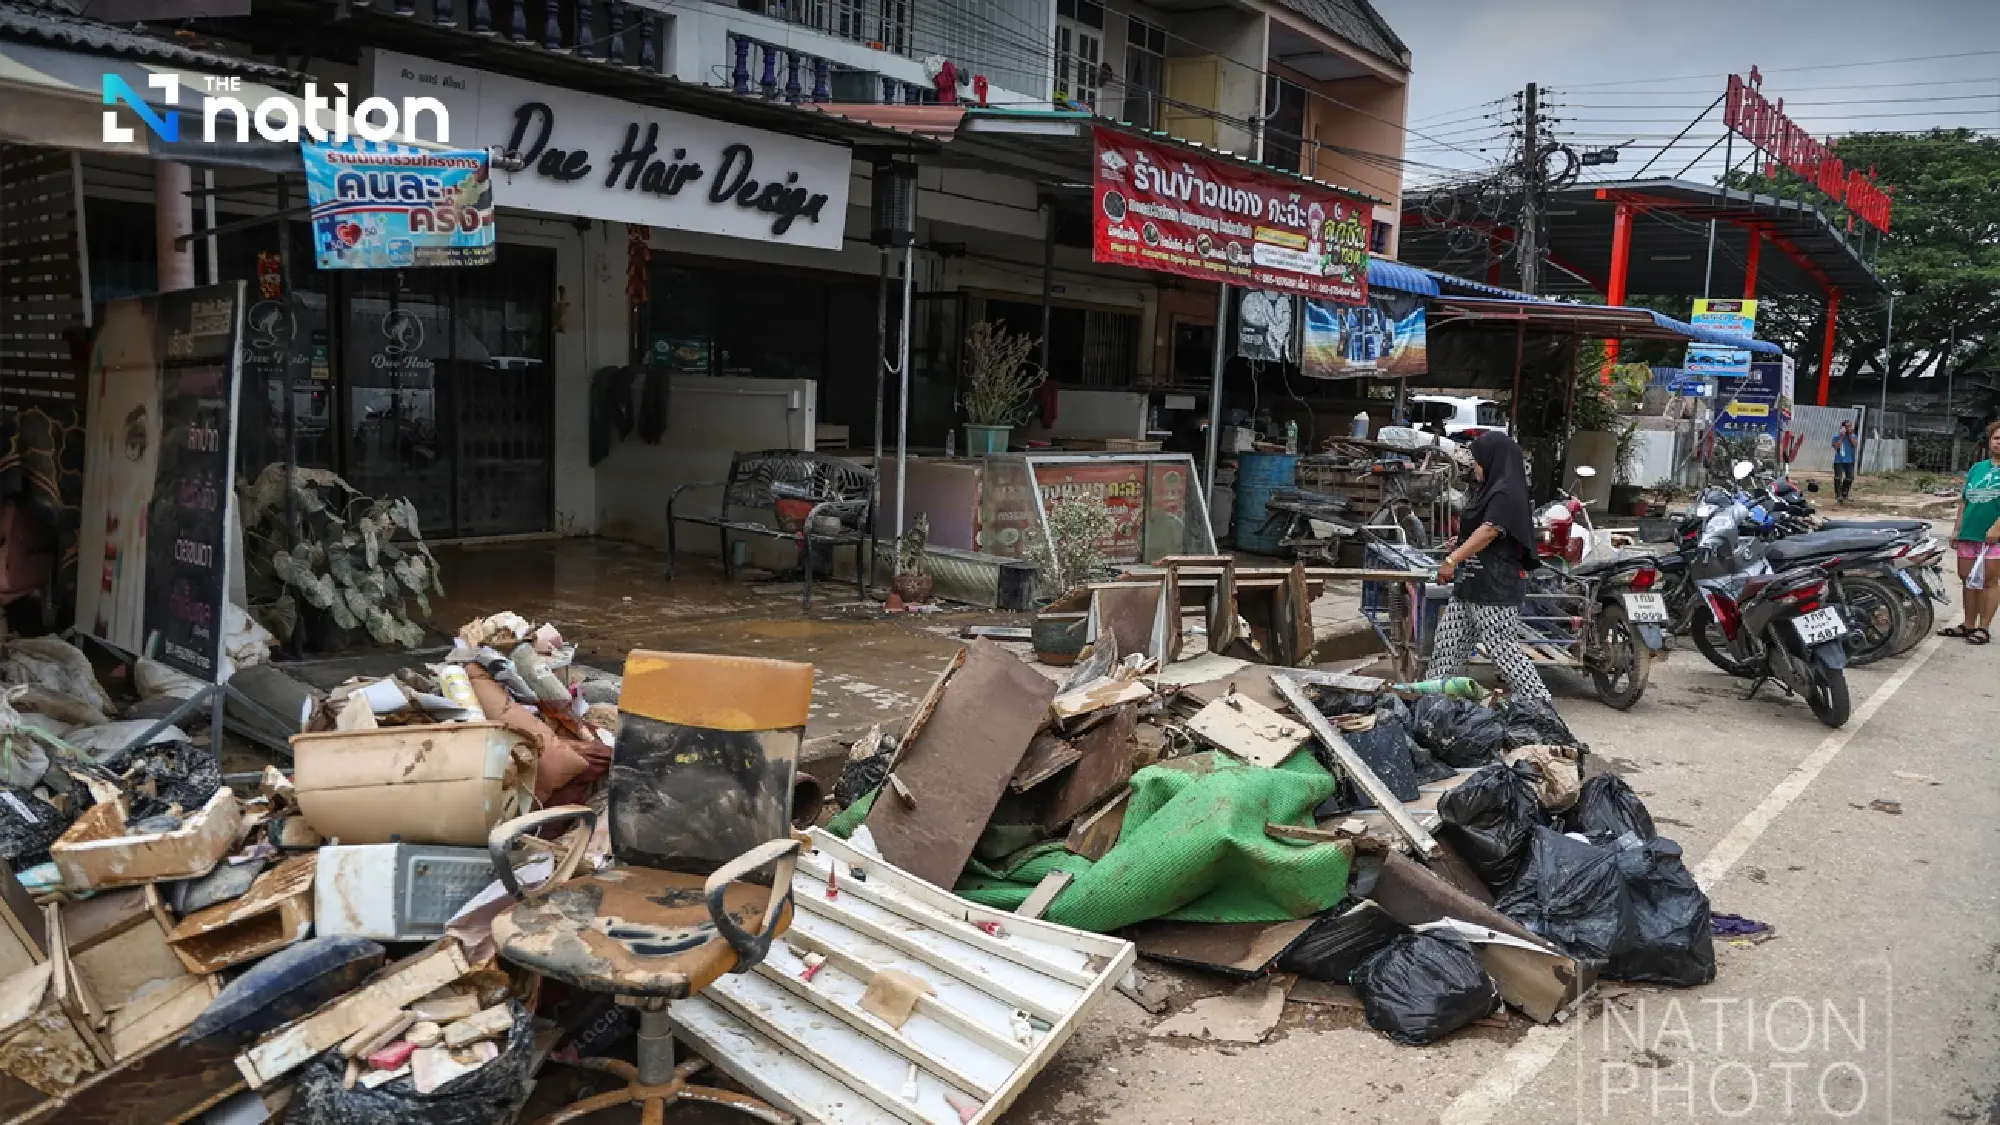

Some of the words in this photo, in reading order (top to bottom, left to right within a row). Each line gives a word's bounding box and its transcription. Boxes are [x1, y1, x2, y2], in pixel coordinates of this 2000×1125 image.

[335, 171, 443, 201] คนละ
[605, 122, 703, 195] Hair
[708, 143, 829, 235] Design
[1133, 150, 1263, 218] ร้านข้าวแกง
